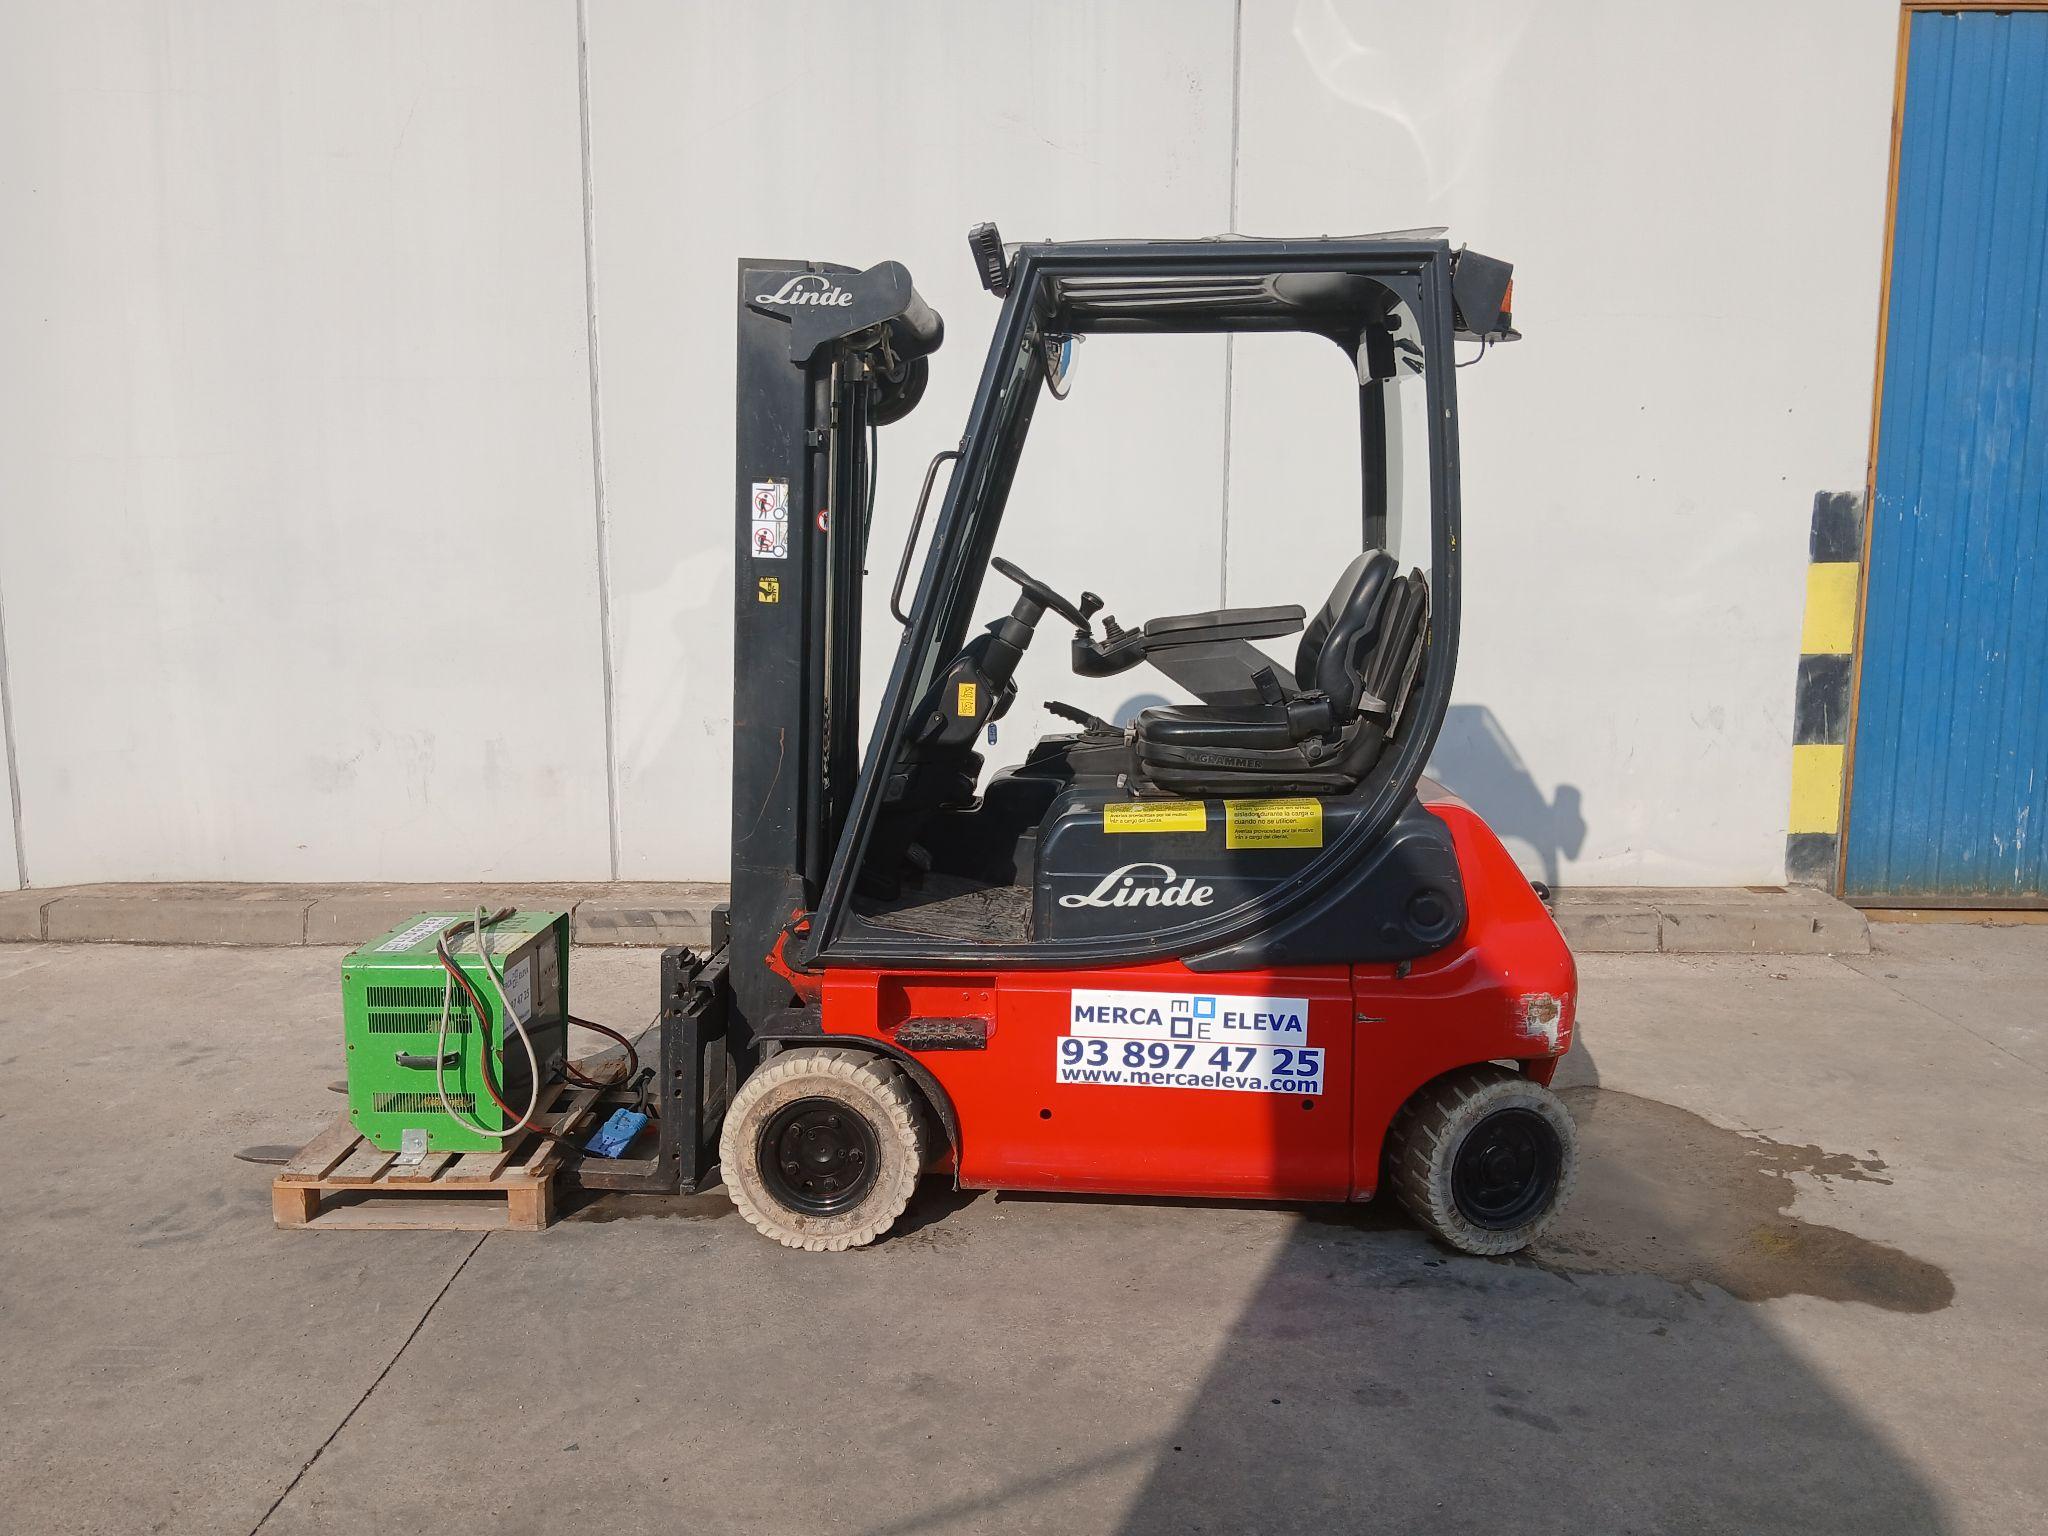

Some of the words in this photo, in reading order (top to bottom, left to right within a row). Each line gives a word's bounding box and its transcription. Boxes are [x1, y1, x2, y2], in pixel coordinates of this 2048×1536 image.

[755, 275, 853, 307] Linde
[1200, 753, 1263, 769] GRAMMER
[1058, 862, 1214, 908] Linde
[1074, 1005, 1163, 1026] MERCA
[1223, 1012, 1303, 1032] ELEVA
[1061, 1038, 1109, 1066] 93
[1121, 1041, 1196, 1070] 897
[1207, 1046, 1257, 1073] 47
[1271, 1048, 1319, 1077] 25
[1062, 1068, 1318, 1093] www.mercaeleva.com
